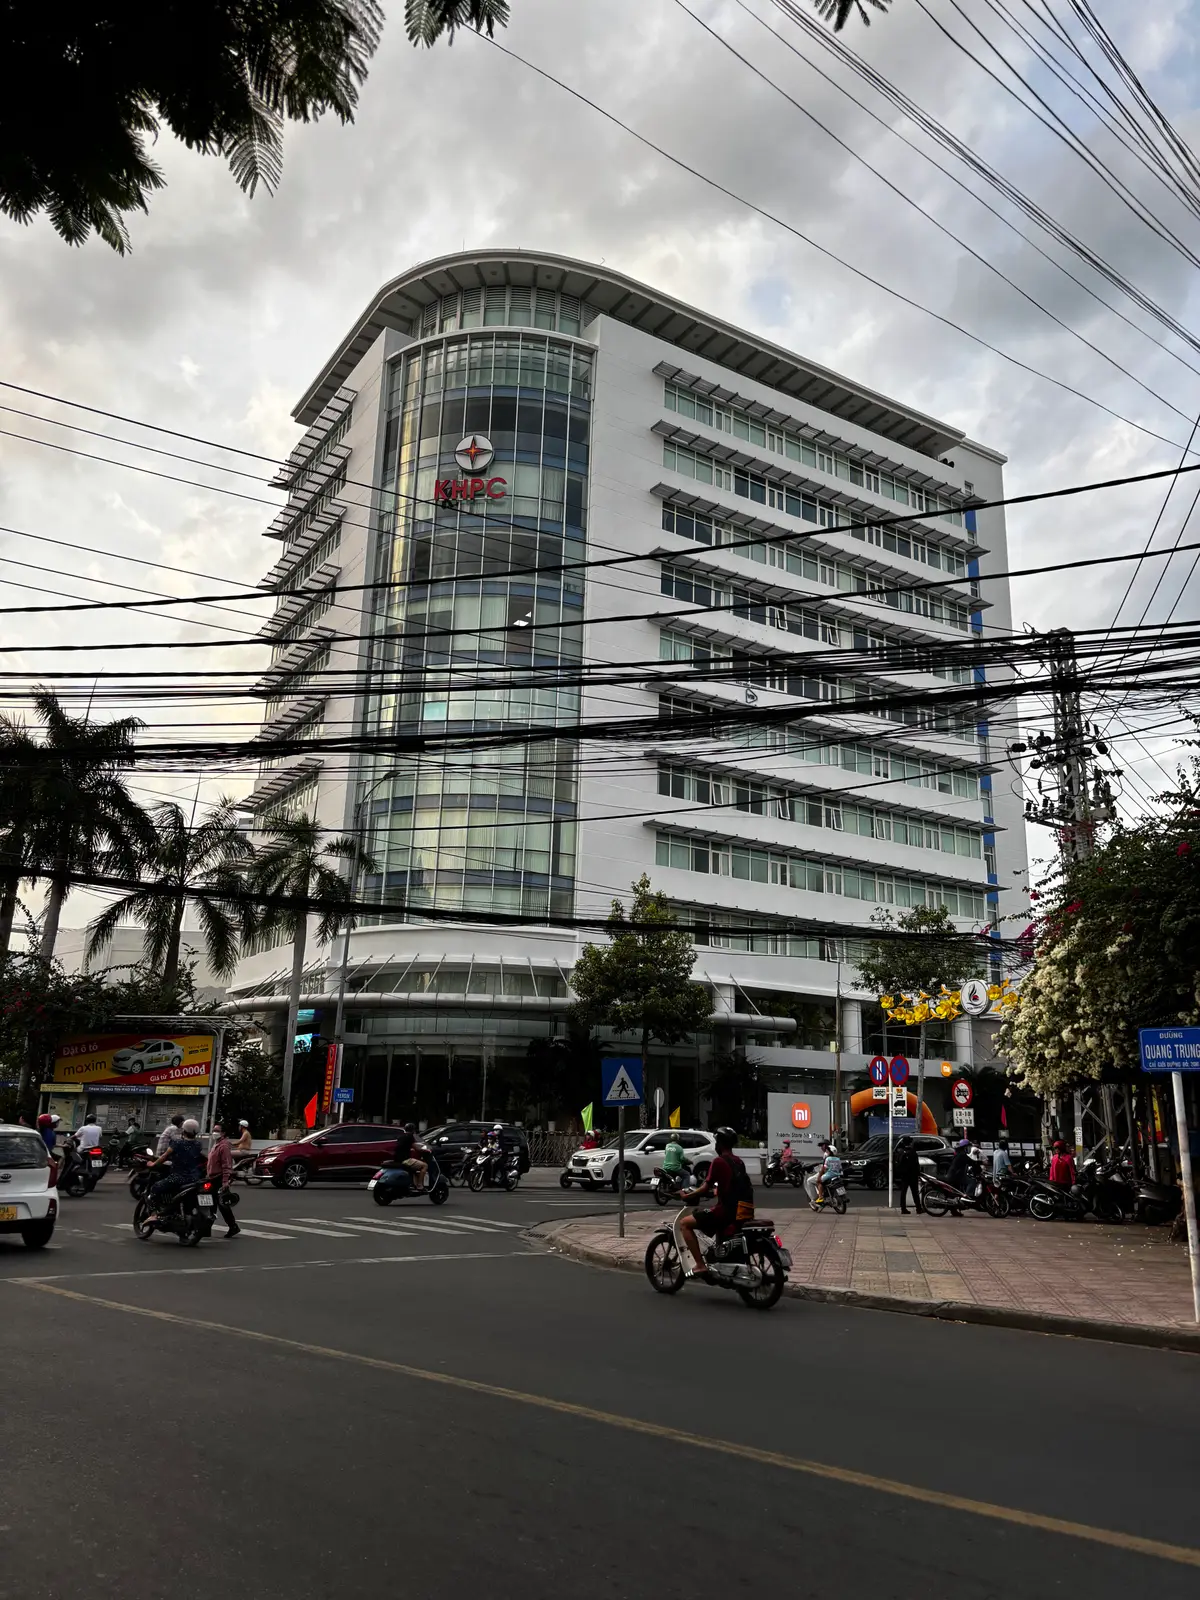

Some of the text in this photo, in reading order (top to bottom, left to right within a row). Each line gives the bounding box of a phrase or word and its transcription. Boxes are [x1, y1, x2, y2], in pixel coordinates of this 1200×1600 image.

[434, 477, 507, 501] KHPC
[1145, 1044, 1200, 1059] QUANG TRUNG
[63, 1059, 107, 1076] maxim
